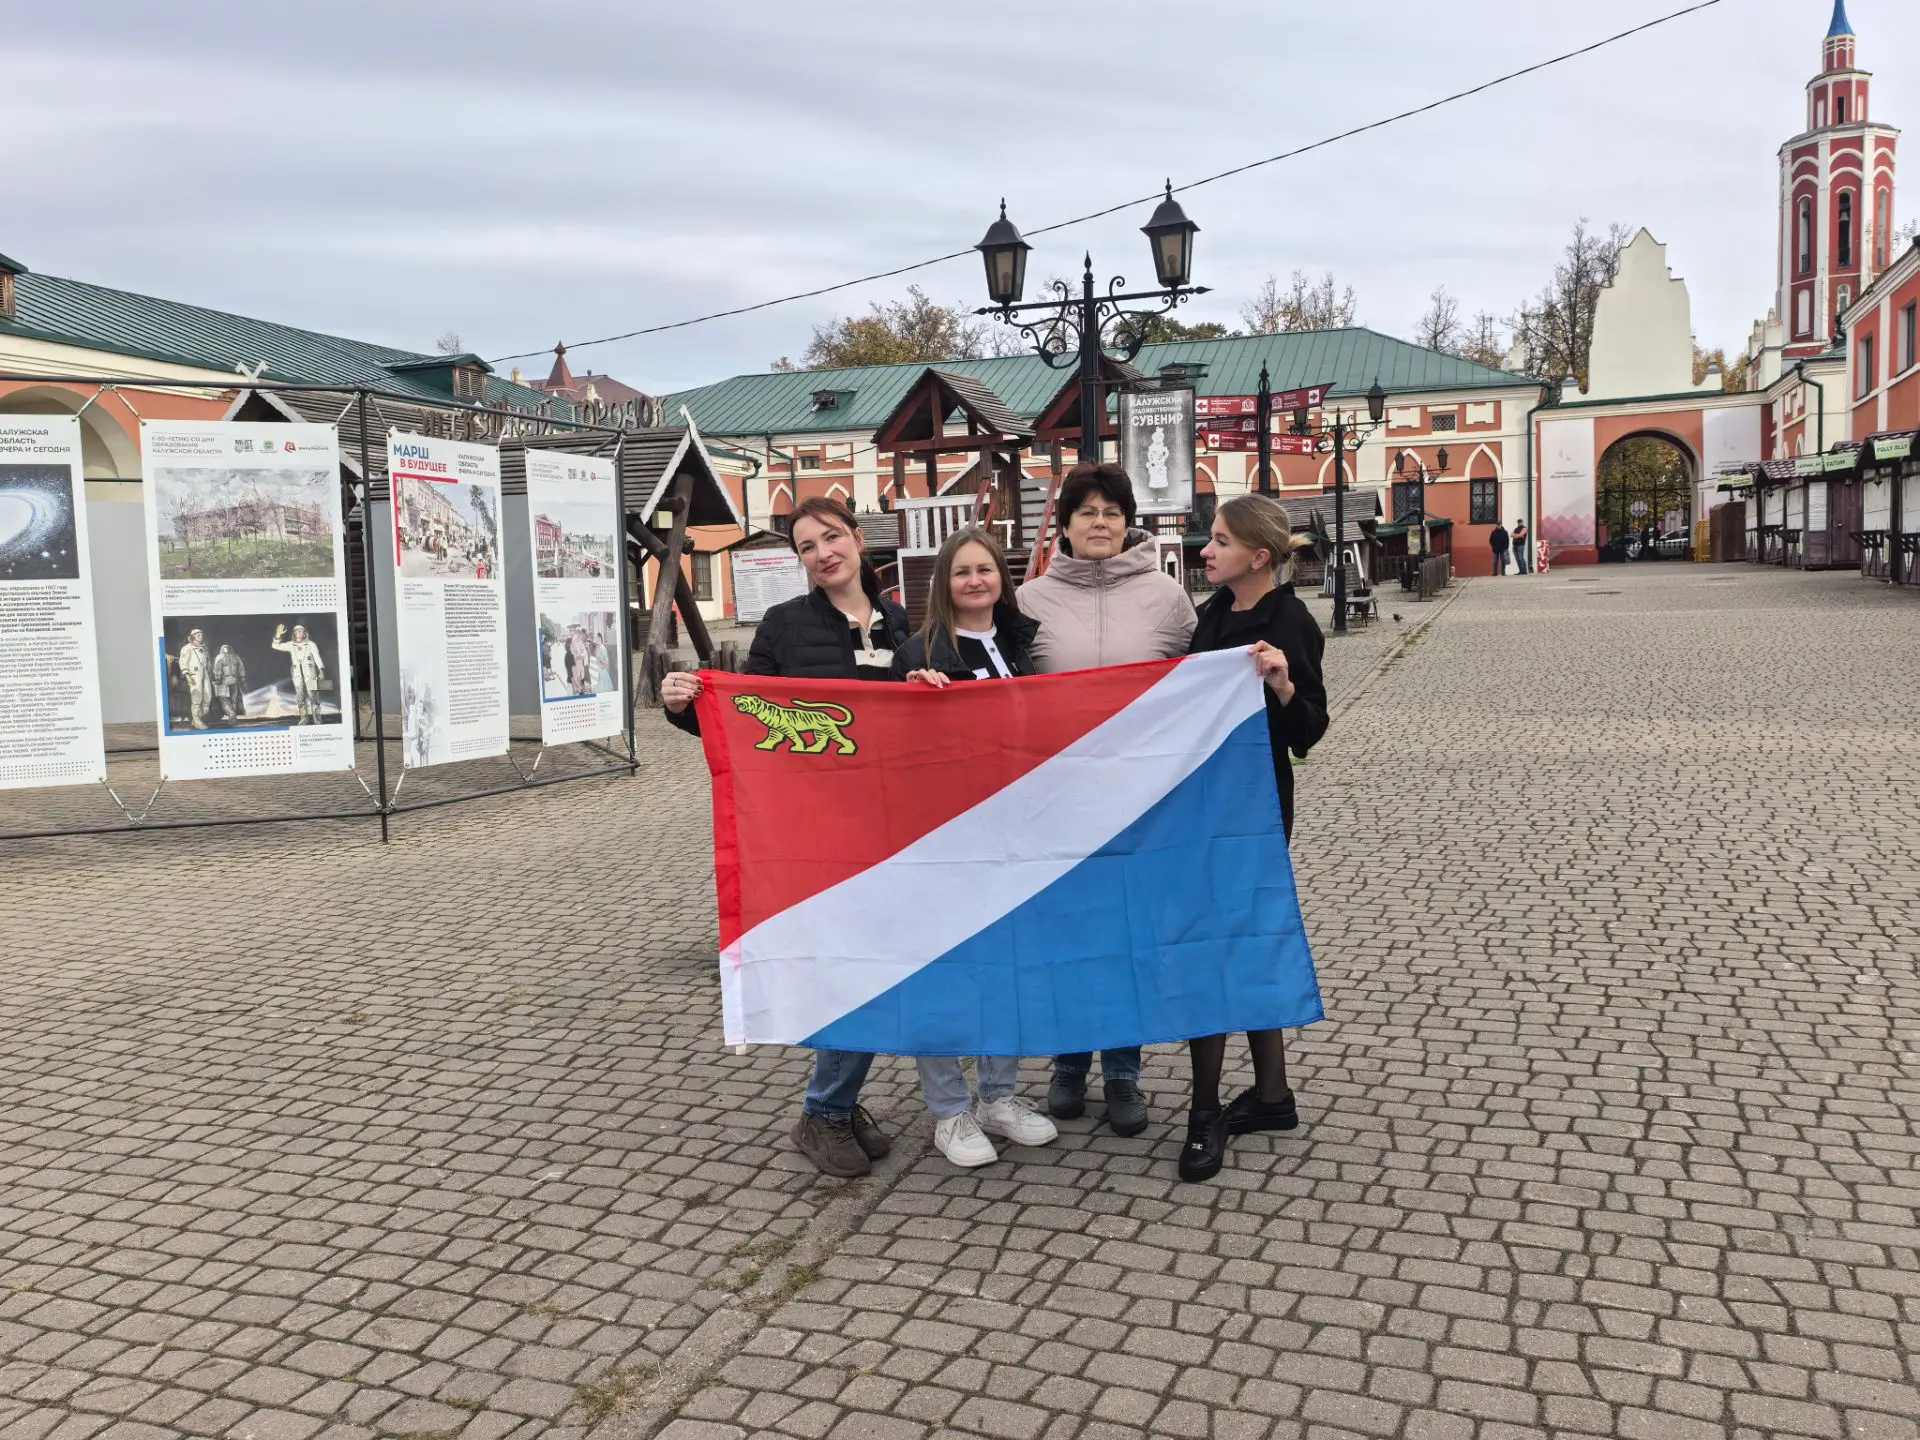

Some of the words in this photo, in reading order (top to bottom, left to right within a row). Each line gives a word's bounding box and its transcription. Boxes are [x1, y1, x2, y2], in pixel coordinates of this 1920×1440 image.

[1131, 396, 1183, 407] КАЛУЖСКИЙ
[1130, 413, 1183, 427] СУВЕНИР
[393, 443, 429, 459] МАРШ
[400, 459, 406, 468] В
[407, 459, 447, 473] БУДУЩЕЕ
